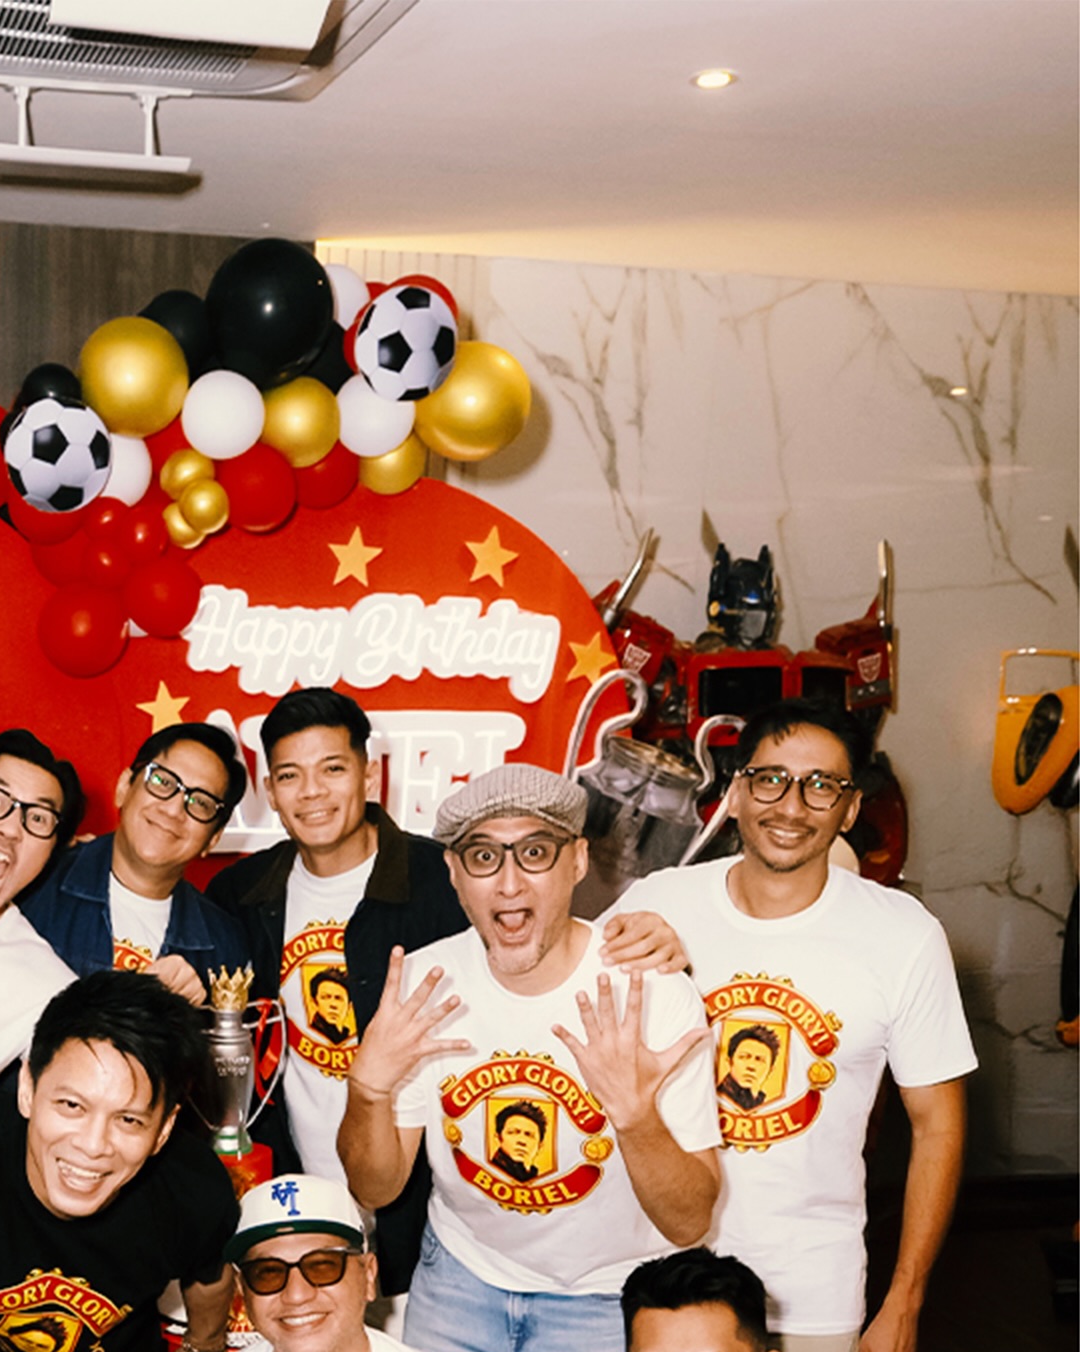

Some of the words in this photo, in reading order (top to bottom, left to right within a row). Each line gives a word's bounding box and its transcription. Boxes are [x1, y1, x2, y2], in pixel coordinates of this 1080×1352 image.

[192, 594, 343, 683] Happy
[354, 602, 554, 690] Birthday
[705, 985, 760, 1017] LORY
[763, 987, 830, 1047] GLORY!
[451, 1063, 521, 1108] GLORY
[523, 1064, 596, 1126] GLORY!
[719, 1110, 803, 1140] ORIEL
[472, 1169, 579, 1206] BORIEL
